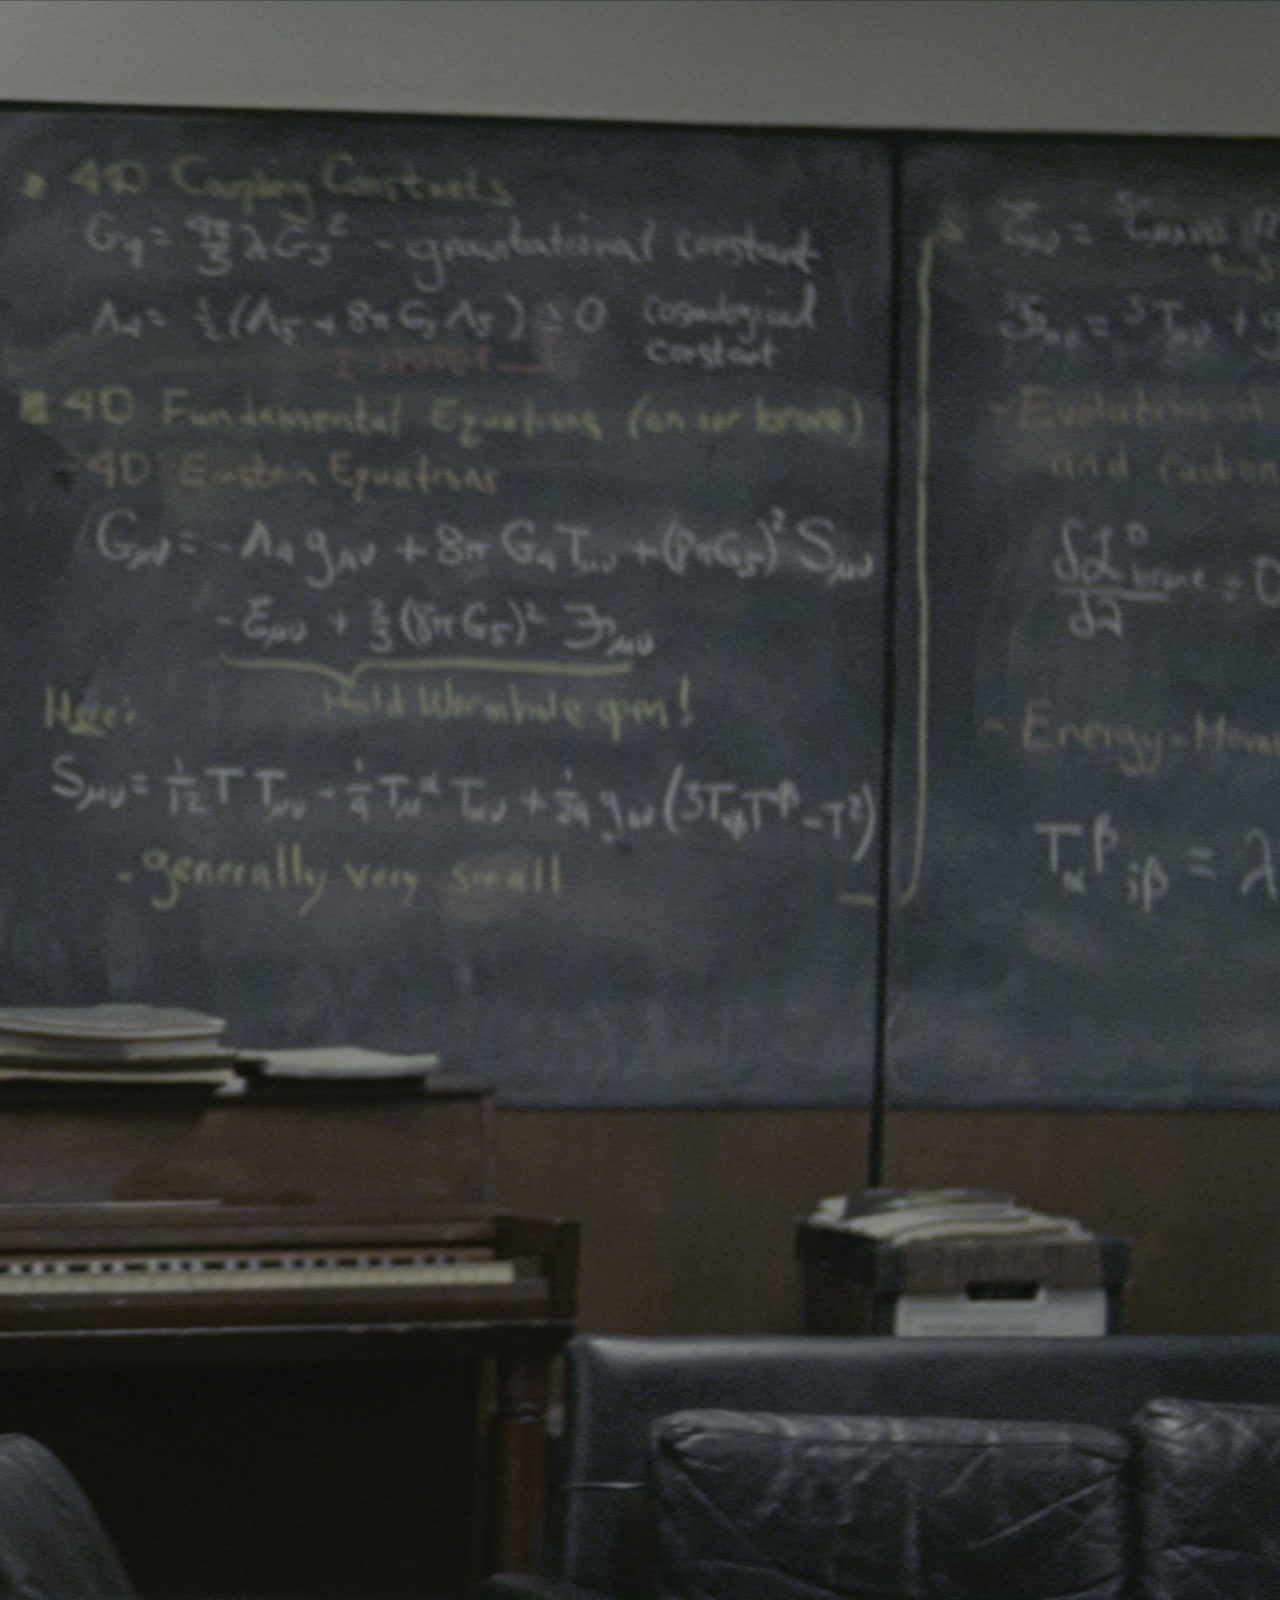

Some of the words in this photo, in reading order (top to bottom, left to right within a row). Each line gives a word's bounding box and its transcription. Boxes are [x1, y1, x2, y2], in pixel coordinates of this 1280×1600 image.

[162, 386, 401, 439] Fundamental
[142, 840, 329, 918] generally
[343, 861, 422, 909] very
[447, 852, 563, 896] small
